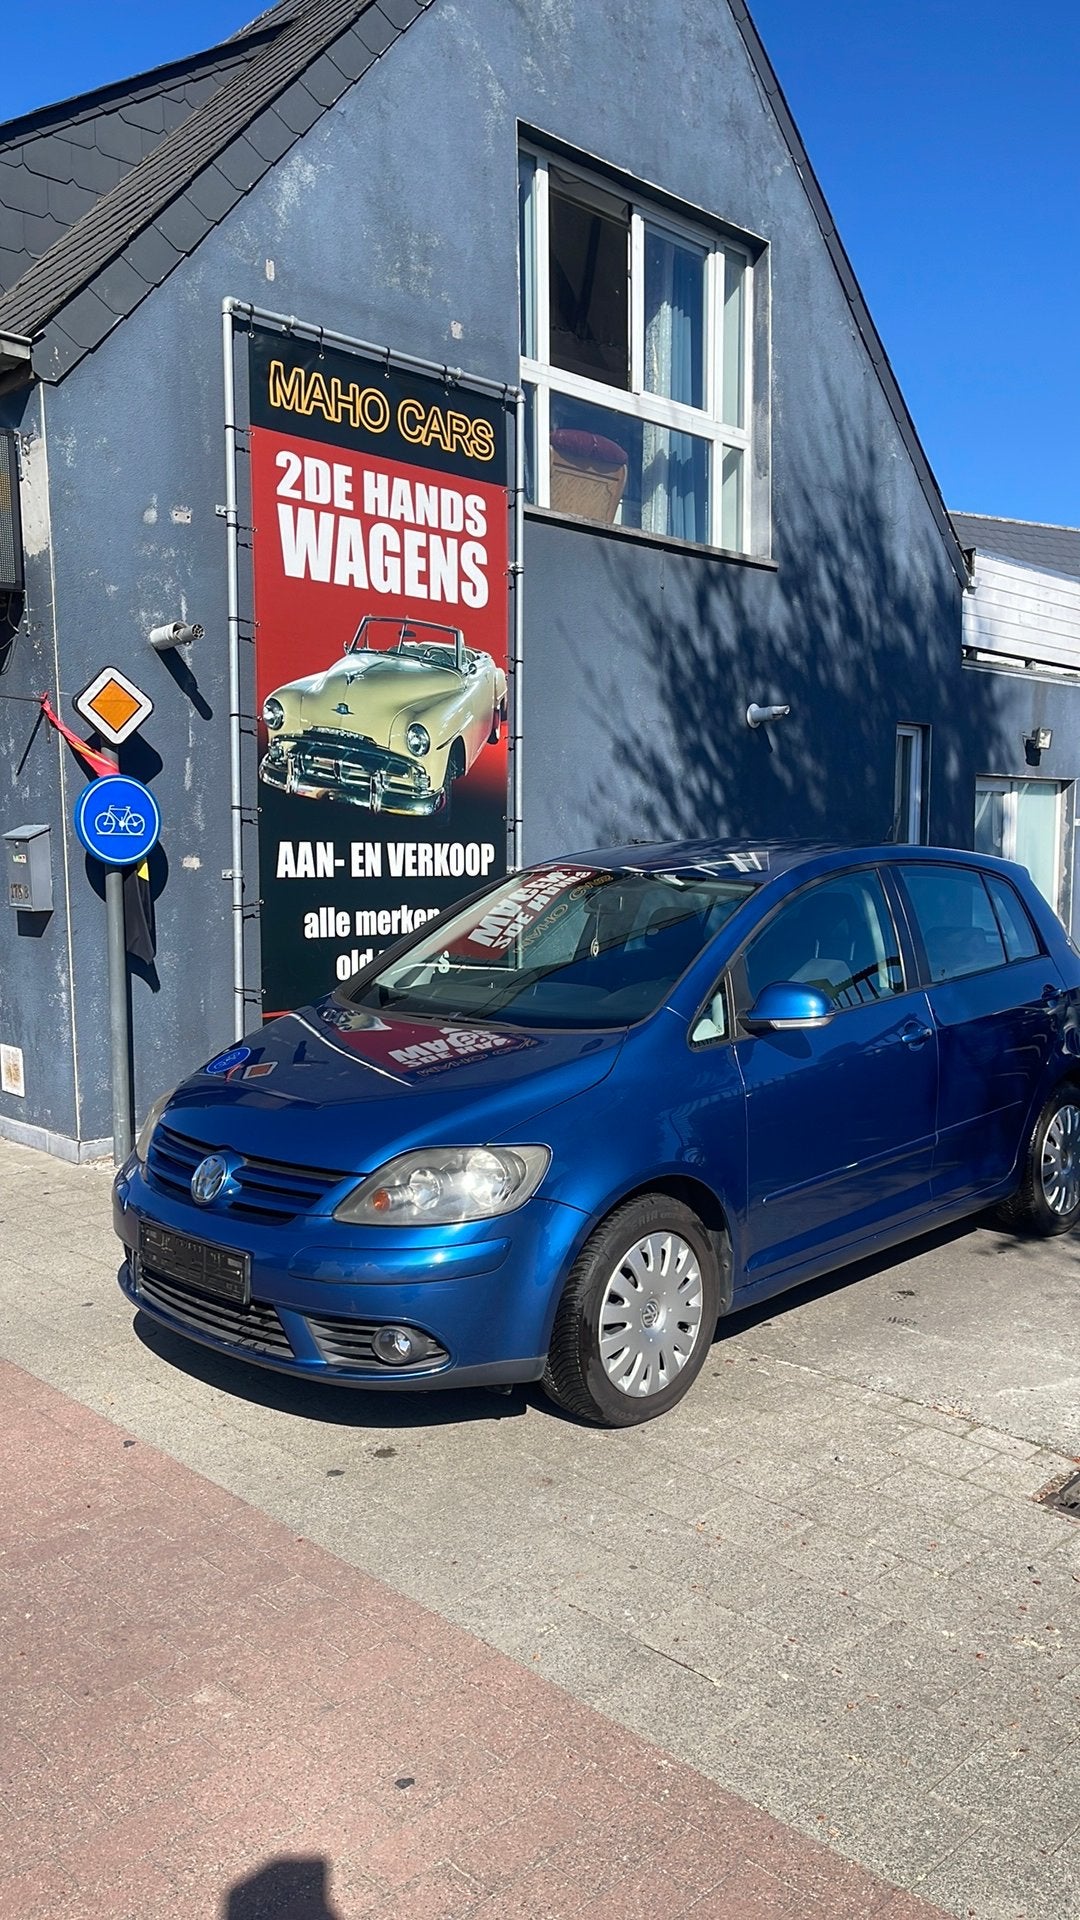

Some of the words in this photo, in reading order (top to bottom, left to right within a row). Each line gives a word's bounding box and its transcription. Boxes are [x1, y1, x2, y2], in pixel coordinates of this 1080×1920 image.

[269, 360, 390, 433] MAHO
[397, 399, 495, 461] CARS
[275, 450, 354, 510] 2DE
[363, 470, 488, 537] HANDS
[277, 502, 489, 609] WAGENS
[276, 841, 345, 878] AAN-
[351, 842, 382, 878] EN
[387, 842, 495, 878] VERKOOP
[304, 907, 351, 939] alle
